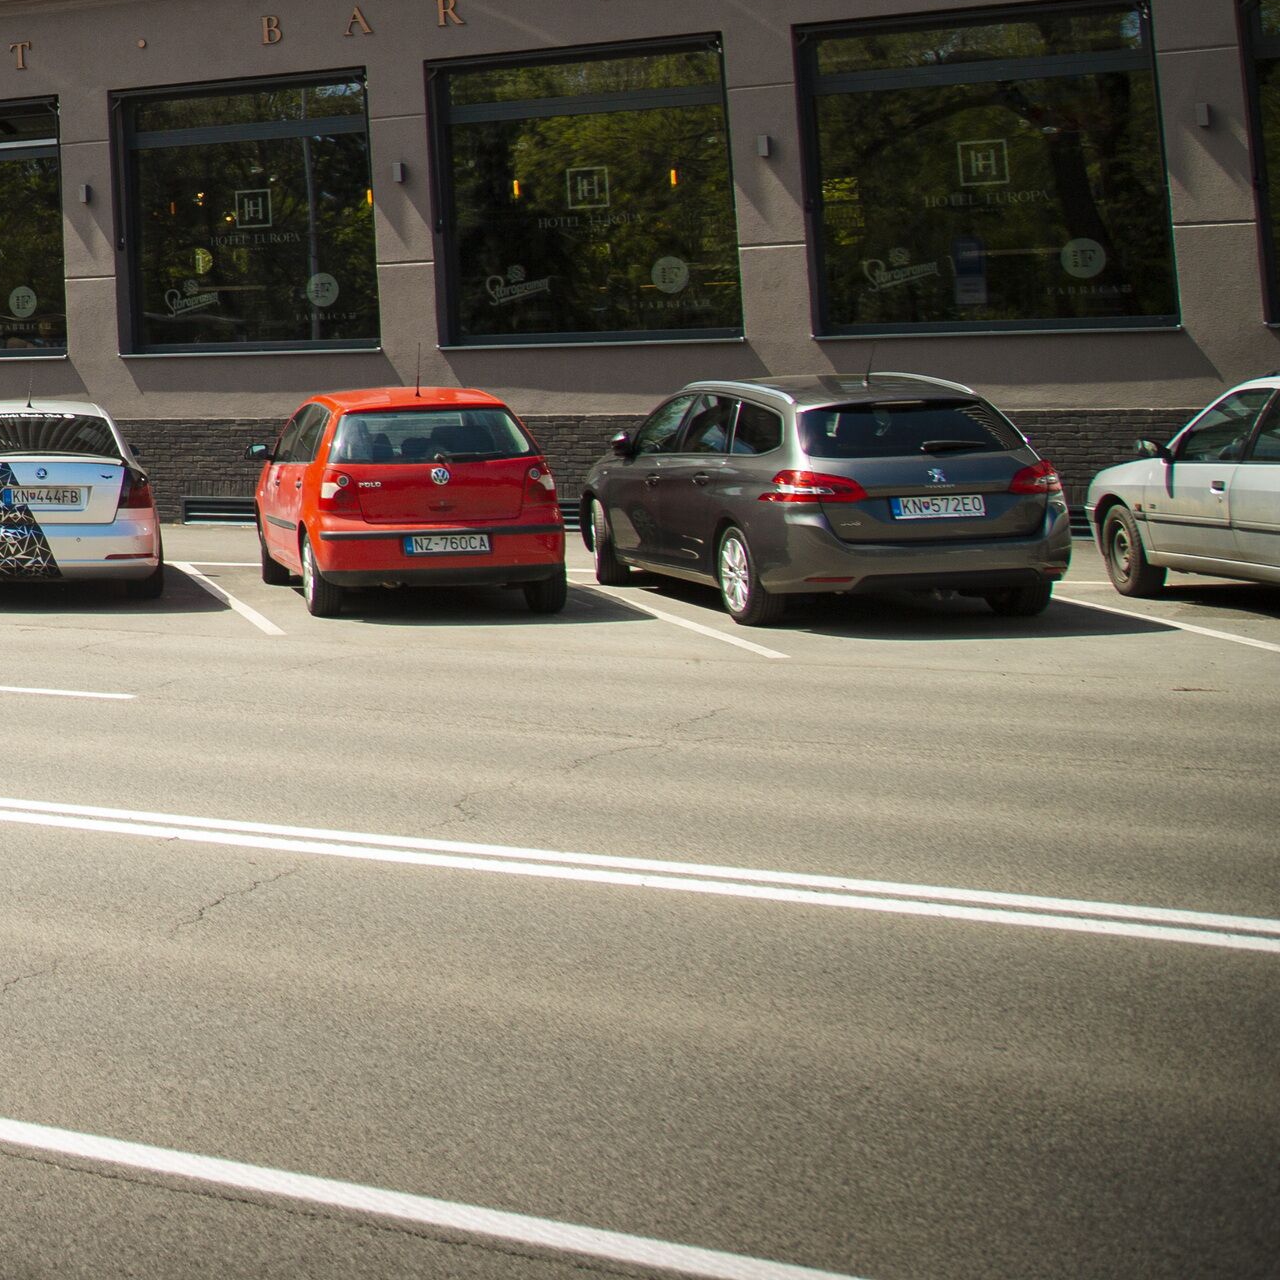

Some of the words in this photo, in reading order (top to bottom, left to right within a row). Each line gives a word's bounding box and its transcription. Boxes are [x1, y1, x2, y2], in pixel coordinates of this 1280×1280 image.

[923, 193, 979, 208] HOTEL
[985, 190, 1051, 205] EUROPA
[210, 233, 245, 246] HOTEL
[253, 231, 302, 244] EUROPA
